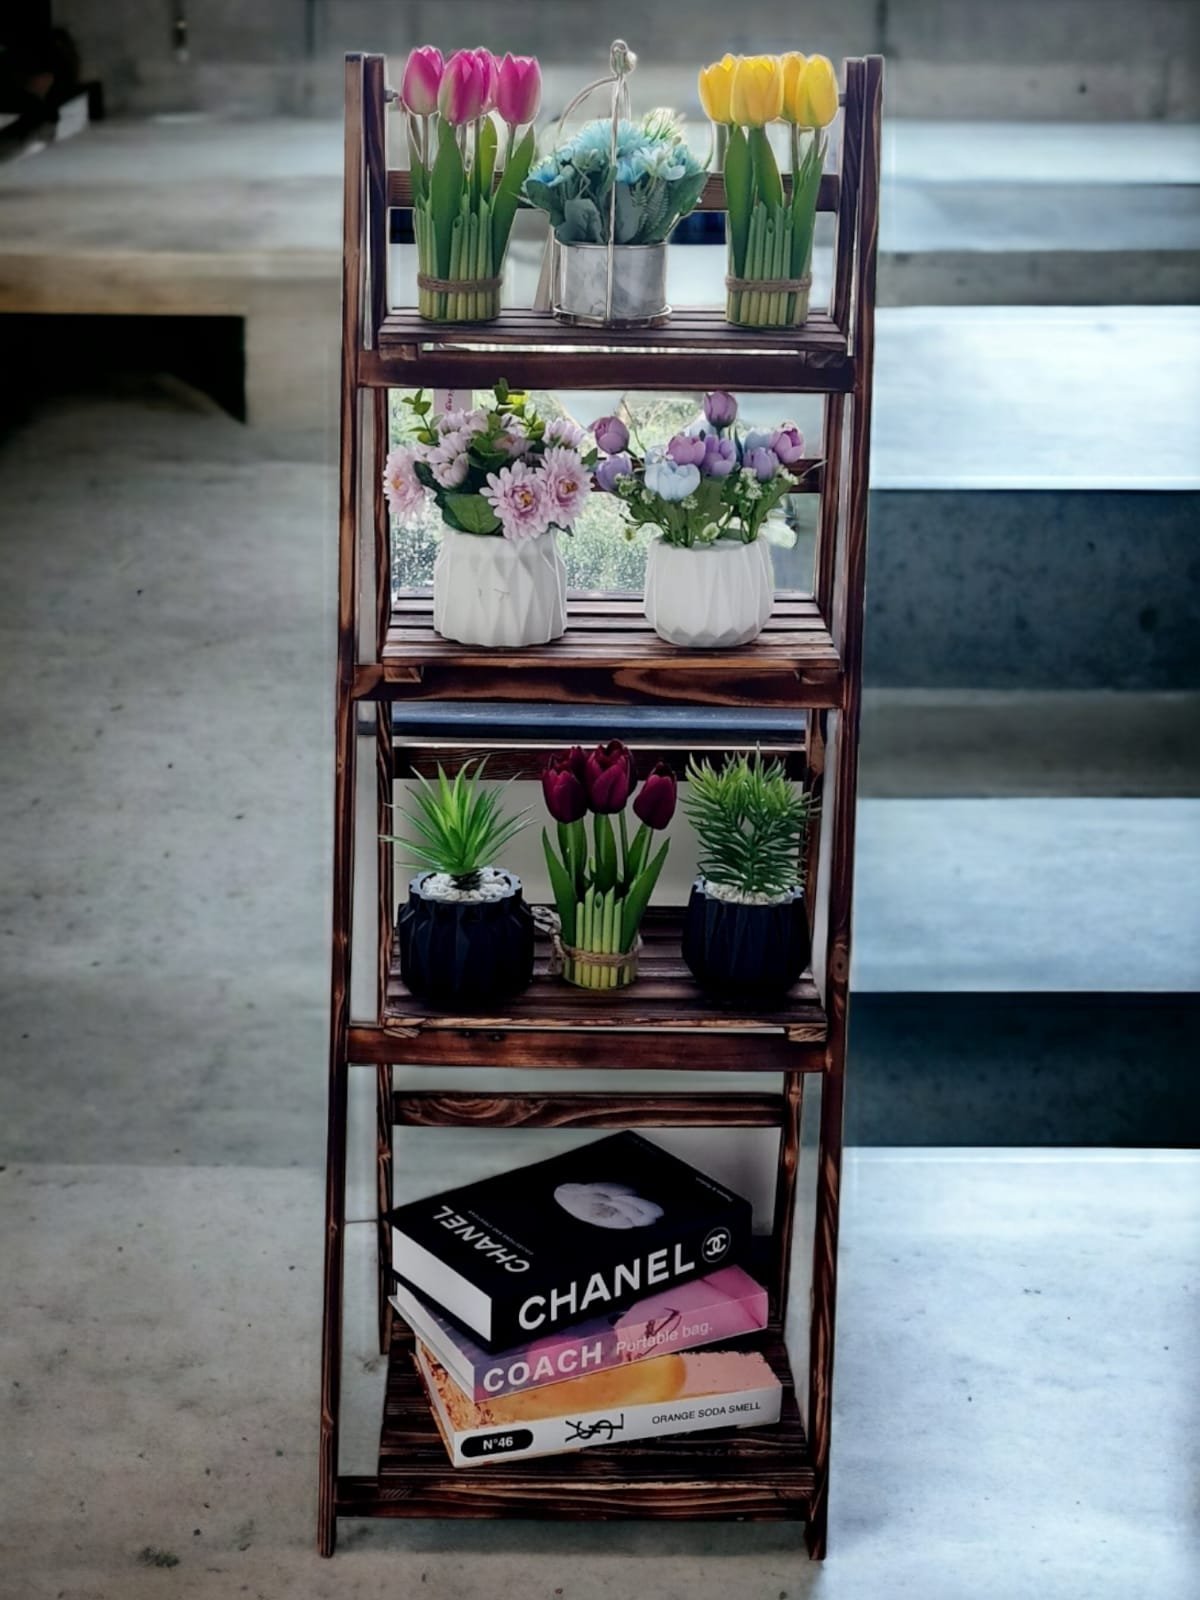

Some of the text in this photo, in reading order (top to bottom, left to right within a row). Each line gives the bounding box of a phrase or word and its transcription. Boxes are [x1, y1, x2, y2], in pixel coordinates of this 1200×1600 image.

[432, 1205, 530, 1272] CHANEL
[518, 1243, 695, 1330] CHANEL
[483, 1321, 713, 1392] COACH Portable bag.
[482, 1436, 514, 1451] N°46
[651, 1410, 696, 1425] ORANGE
[698, 1406, 727, 1419] SODA
[728, 1401, 762, 1414] SMELL
